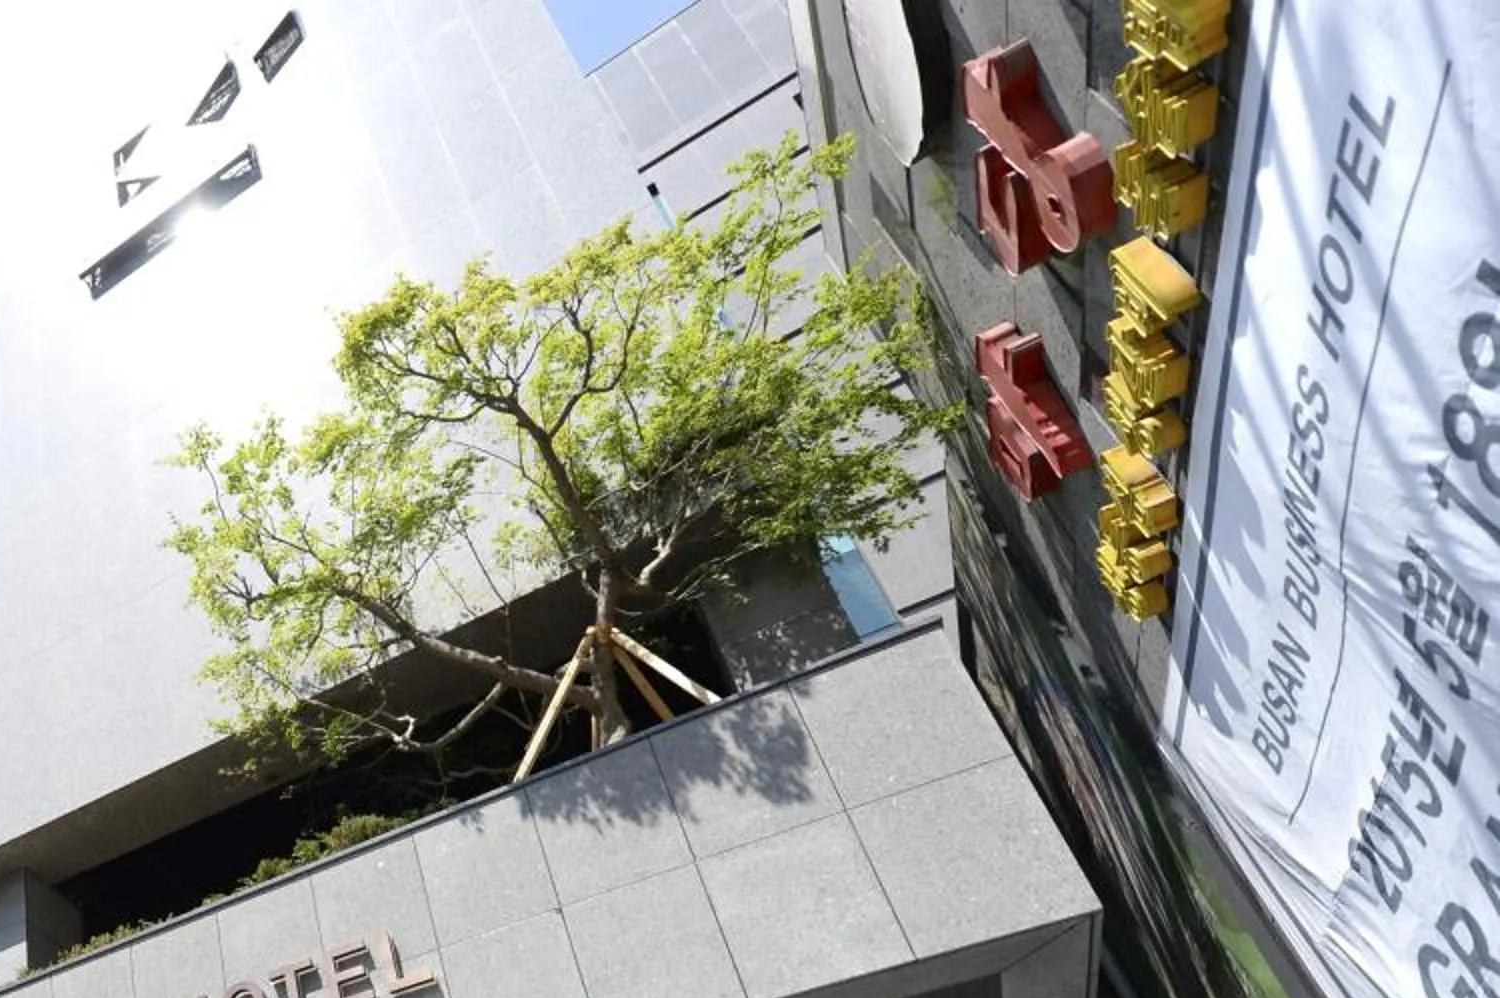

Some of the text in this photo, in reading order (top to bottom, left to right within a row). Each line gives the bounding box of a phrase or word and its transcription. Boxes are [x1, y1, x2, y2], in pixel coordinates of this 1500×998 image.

[1252, 92, 1396, 776] BUSAN BUSINESS HOTEL
[1397, 534, 1490, 701] 5월
[1348, 667, 1467, 915] 2015년
